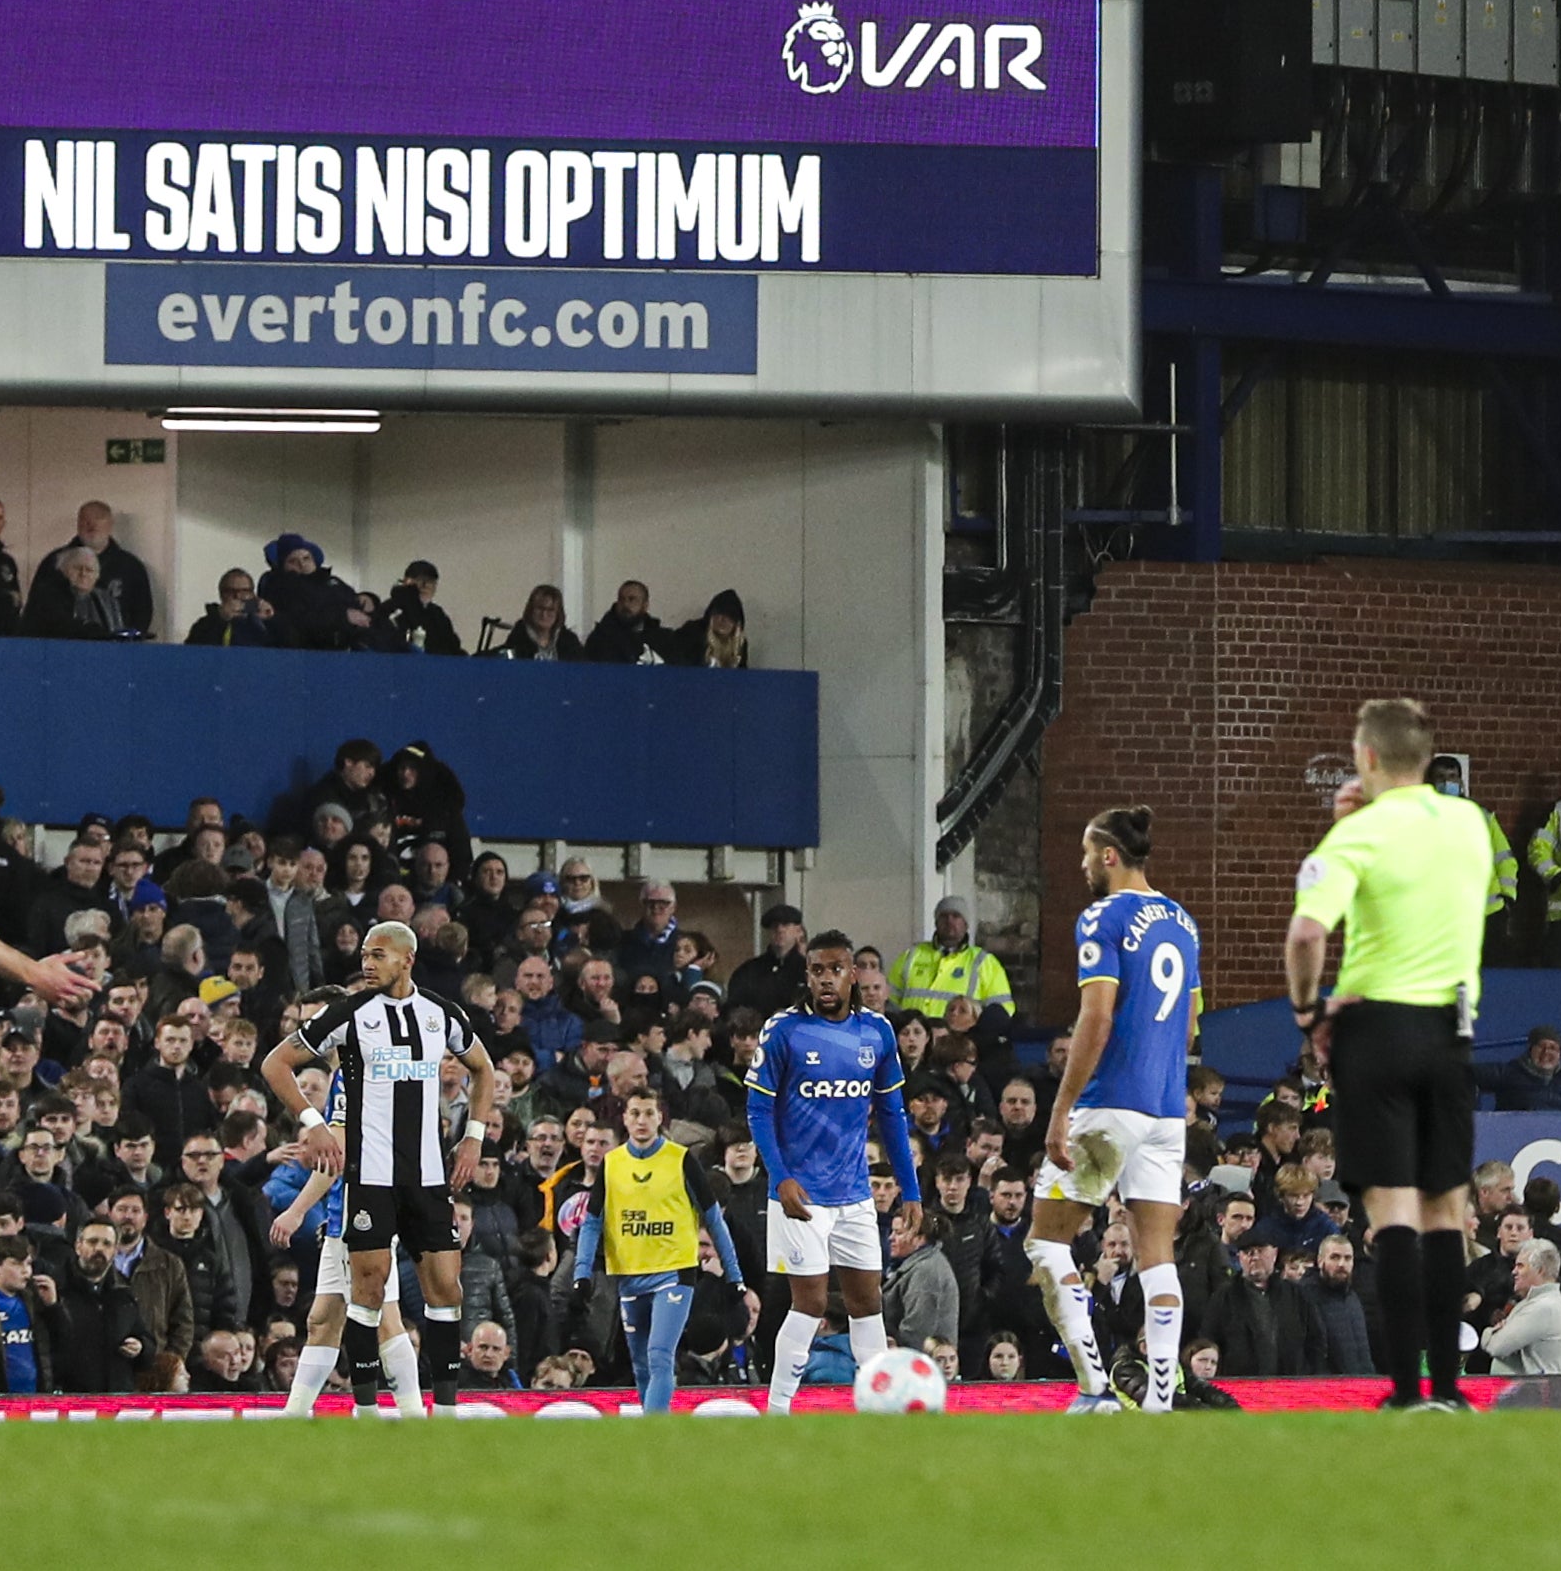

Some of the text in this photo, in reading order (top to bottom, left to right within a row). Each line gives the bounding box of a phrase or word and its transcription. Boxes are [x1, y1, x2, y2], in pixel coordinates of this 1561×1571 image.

[860, 20, 1048, 92] VAR
[23, 138, 821, 264] NIL SATIS NISI OPTIMUM
[156, 280, 710, 350] evertonfc.com
[1150, 941, 1185, 1022] 9
[372, 1061, 438, 1080] FUN88
[799, 1080, 872, 1099] CAZOO
[622, 1221, 674, 1237] FUN88
